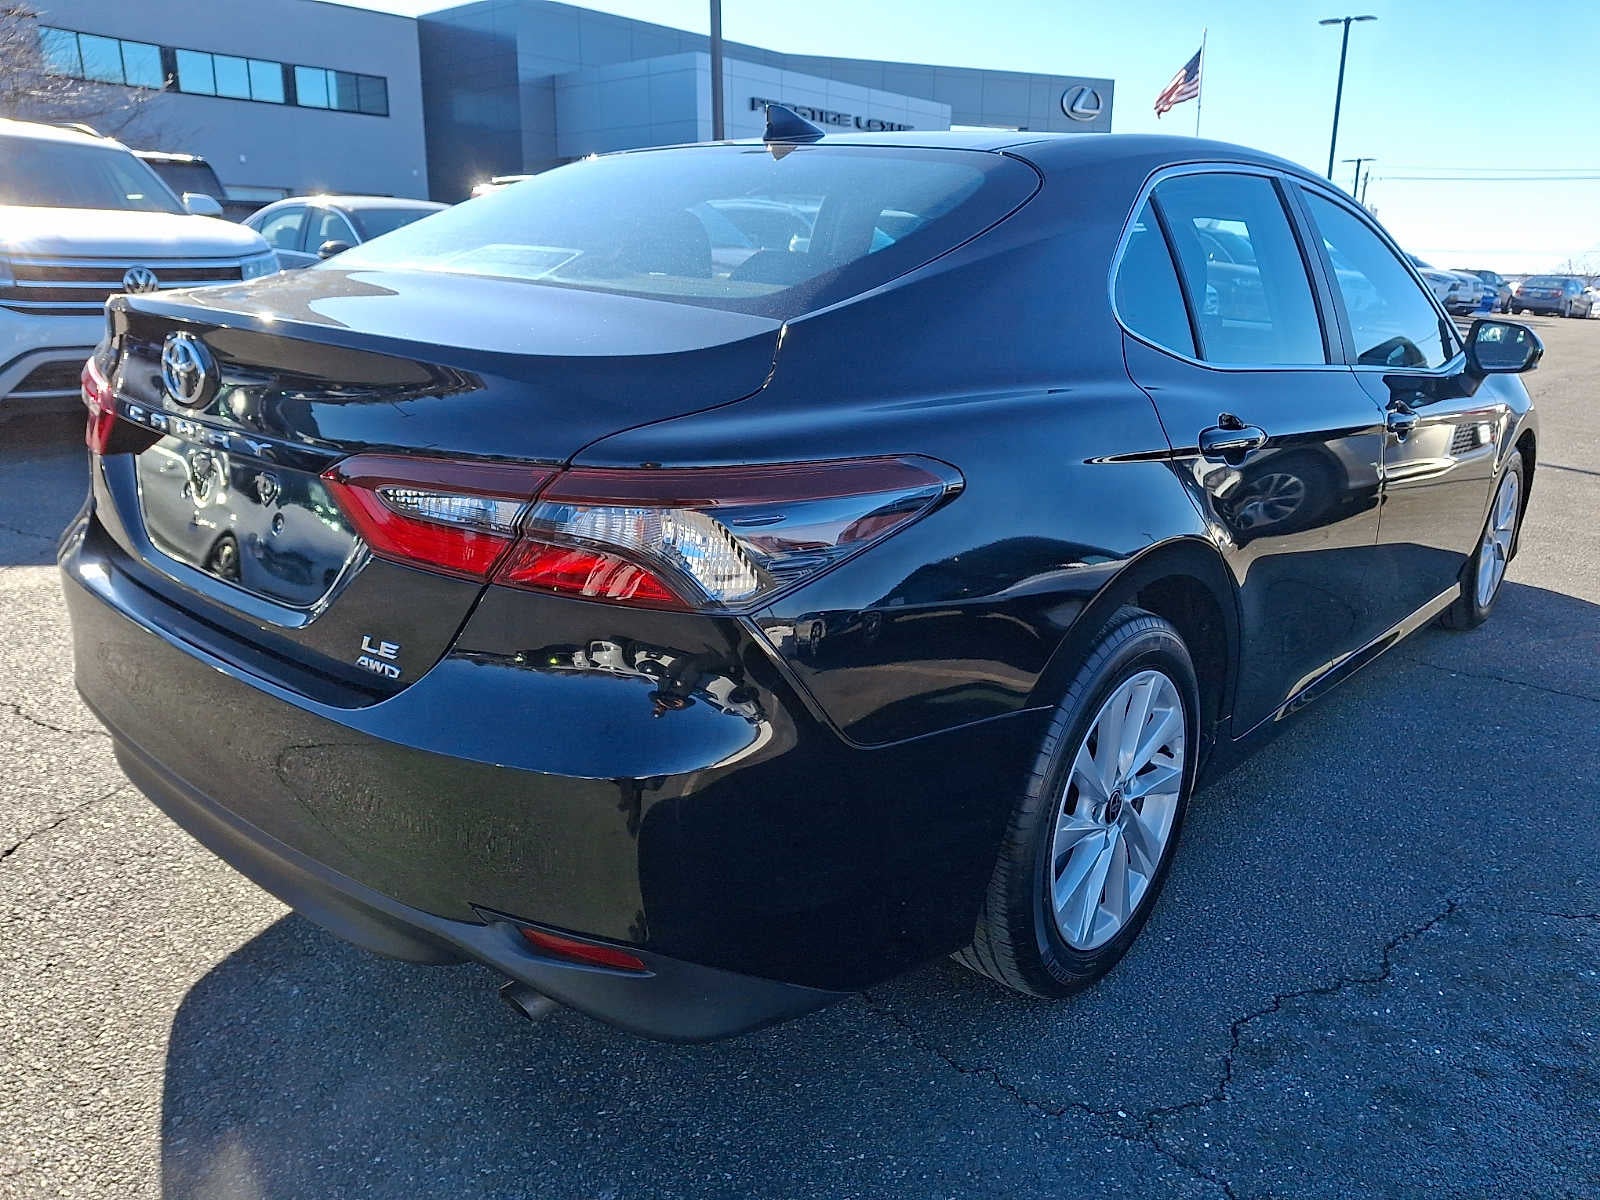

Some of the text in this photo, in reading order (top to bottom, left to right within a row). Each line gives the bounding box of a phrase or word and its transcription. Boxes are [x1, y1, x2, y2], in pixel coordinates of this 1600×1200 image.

[749, 97, 852, 127] PSTIGE
[361, 635, 400, 660] LE
[355, 655, 401, 679] AWD
